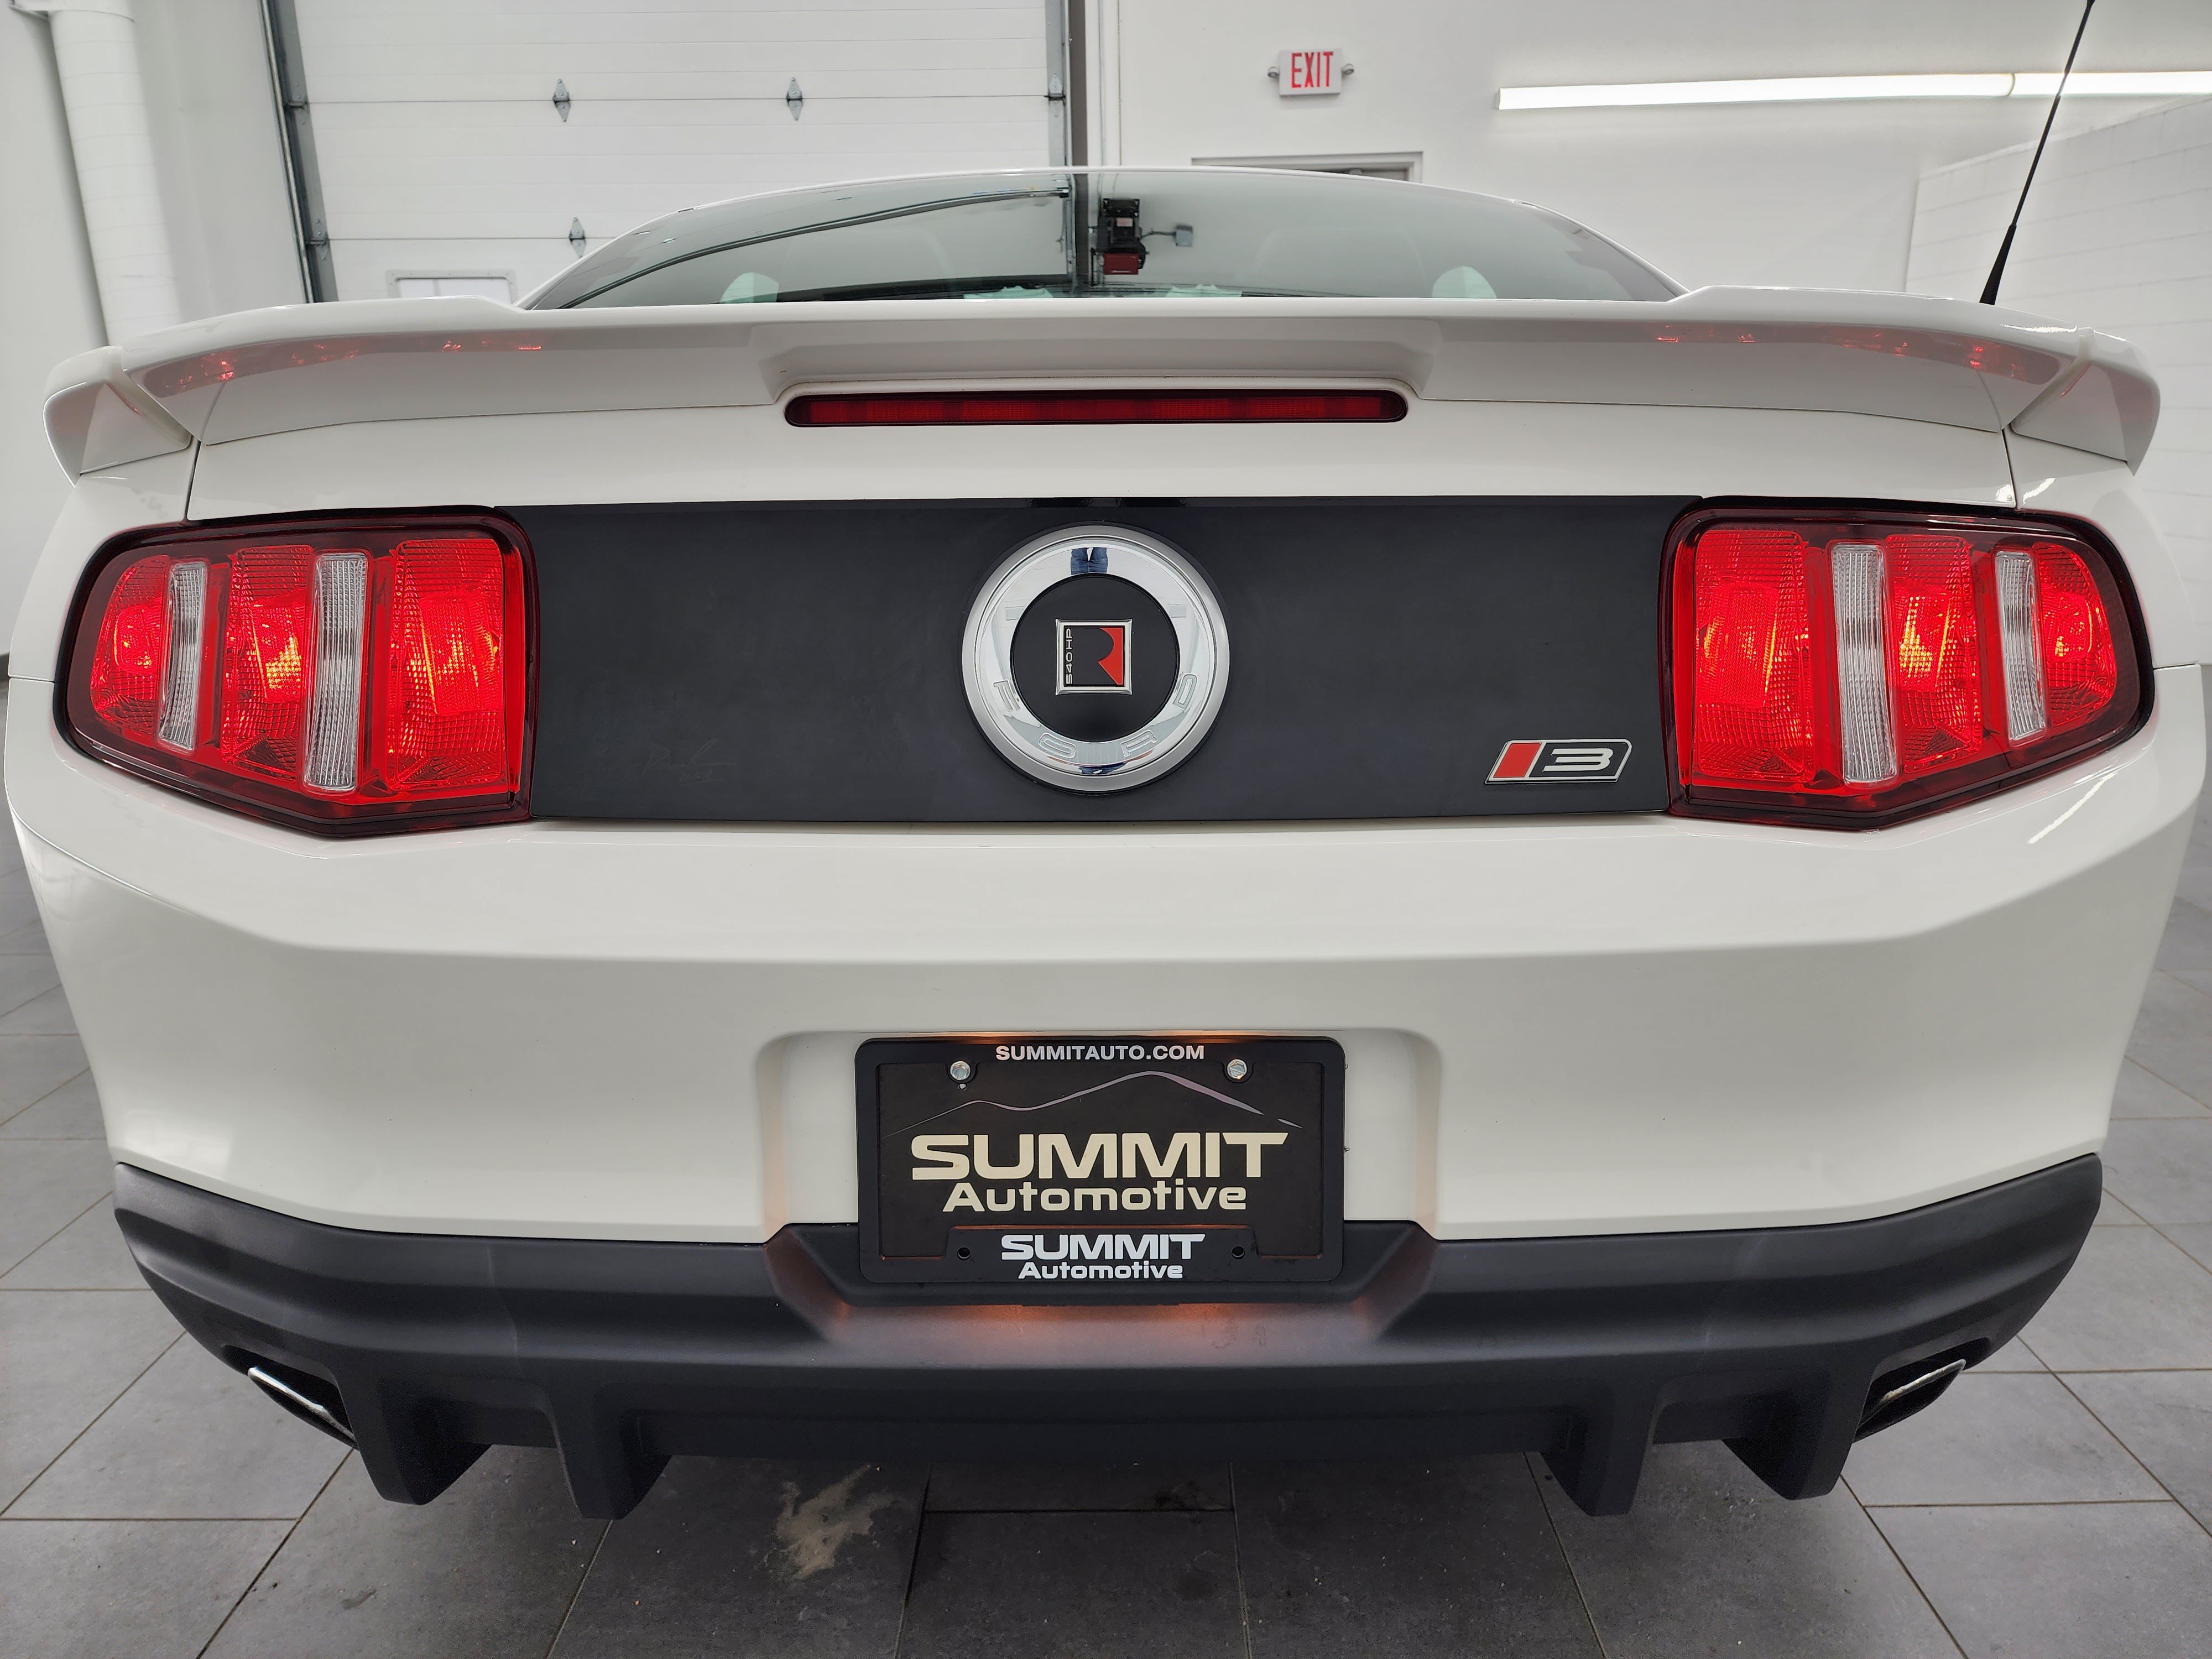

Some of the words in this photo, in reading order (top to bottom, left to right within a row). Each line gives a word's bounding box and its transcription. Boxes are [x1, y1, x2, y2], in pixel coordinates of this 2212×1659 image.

[1291, 51, 1334, 88] EXIT
[993, 674, 1197, 758] FORD
[1542, 748, 1614, 772] 3
[995, 1045, 1204, 1061] SUMMITAUTO.COM
[911, 1132, 1288, 1180] SUMMIT
[942, 1178, 1246, 1212] Automotive
[1001, 1234, 1206, 1260] SUMMIT
[1018, 1260, 1183, 1279] Automotive
